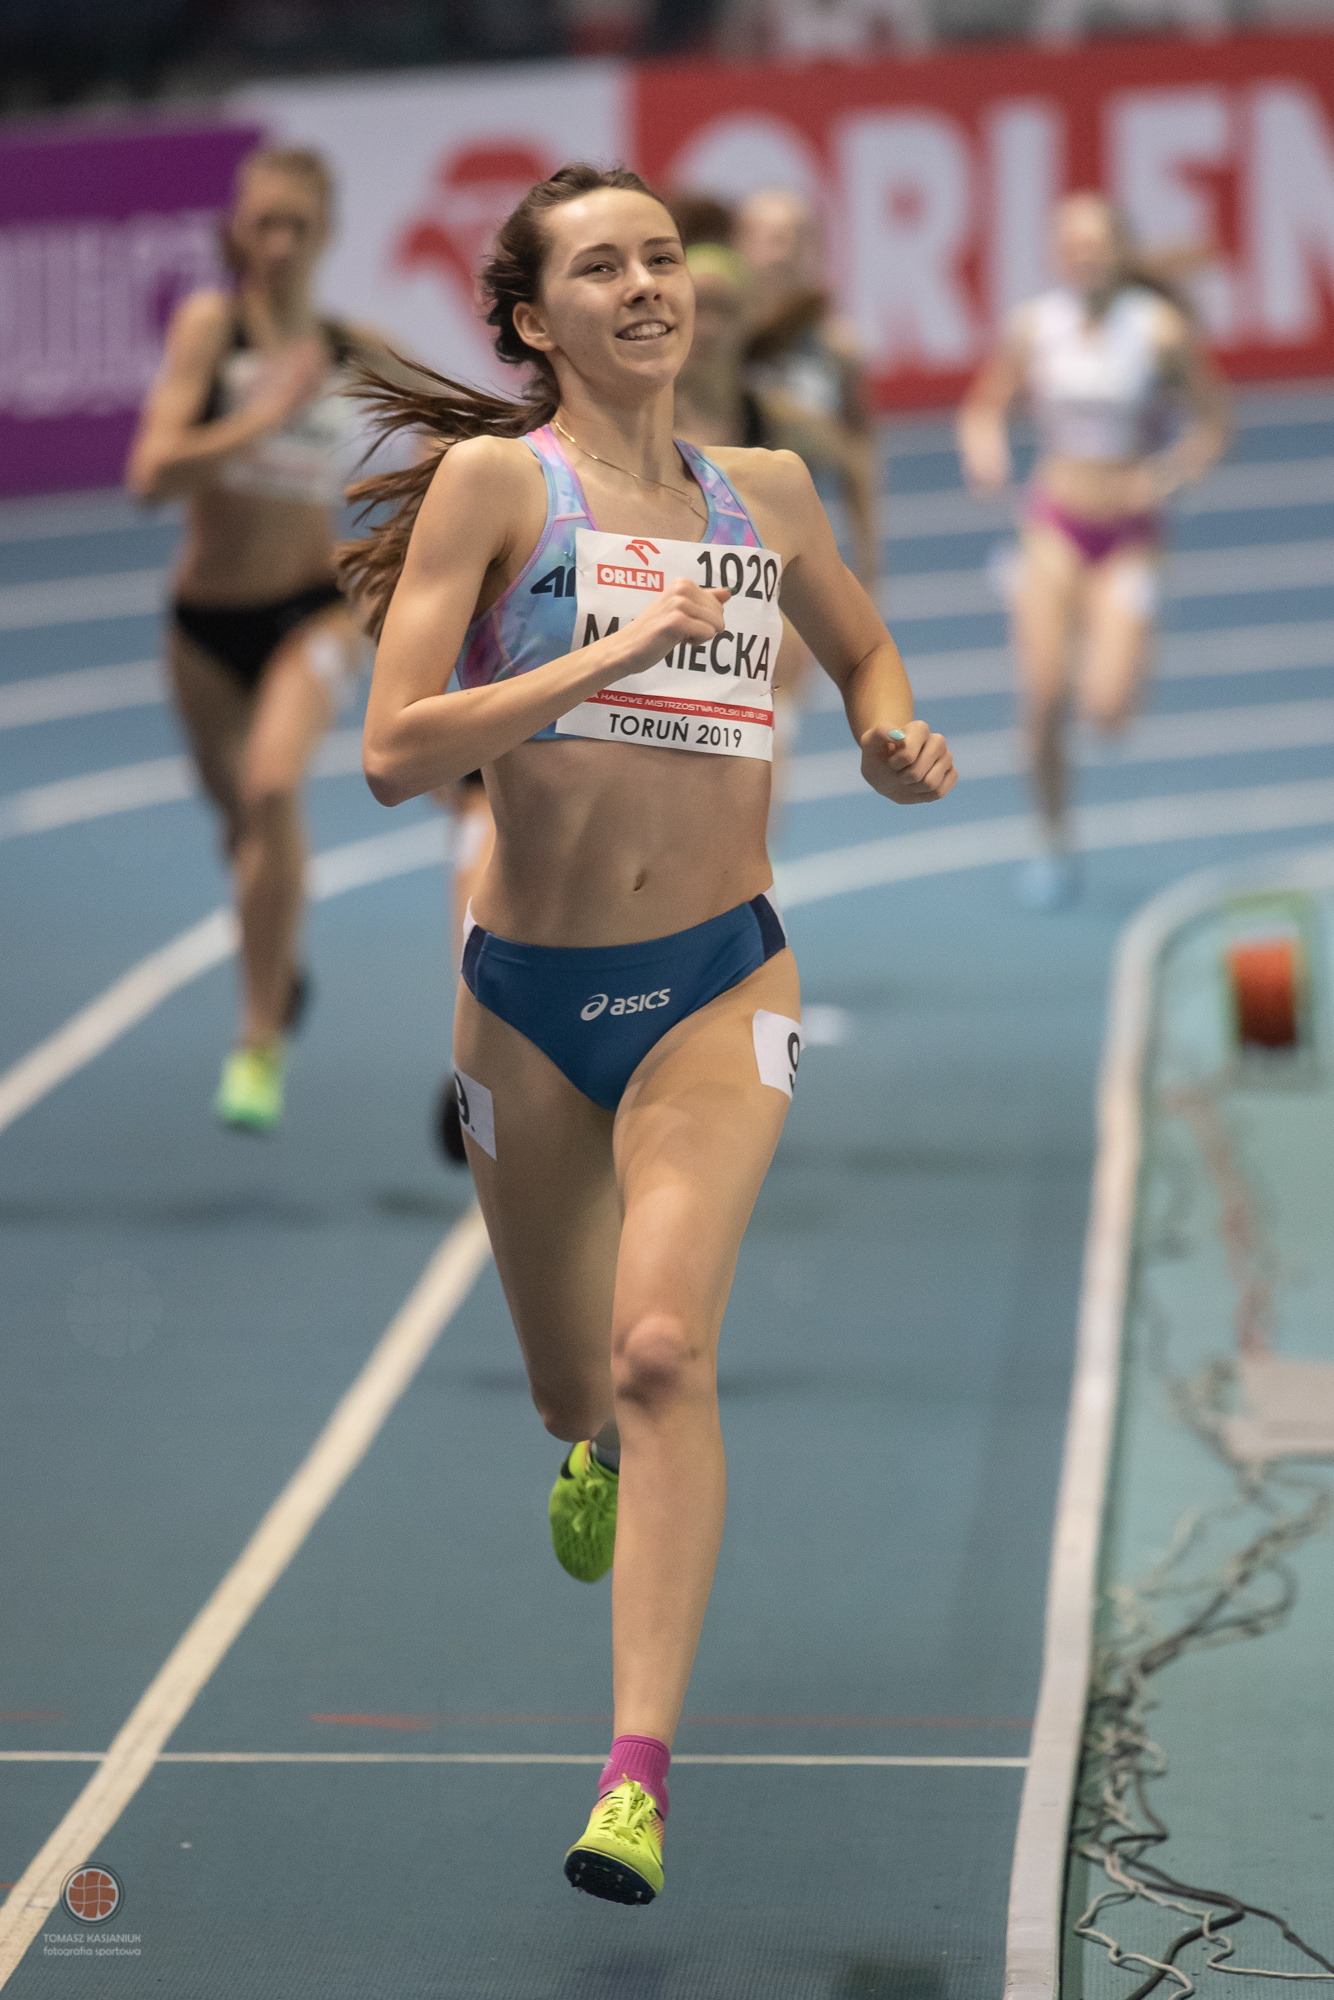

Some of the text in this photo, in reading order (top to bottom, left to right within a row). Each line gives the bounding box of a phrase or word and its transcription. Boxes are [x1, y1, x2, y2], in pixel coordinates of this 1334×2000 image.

[600, 567, 661, 589] ORLEN
[696, 551, 778, 603] 1020
[582, 613, 770, 681] MIECKA
[600, 694, 643, 705] HALOWE
[644, 699, 713, 713] MISTRZOSTWA
[714, 706, 740, 717] POLSKI
[609, 713, 742, 748] TORUŃ 2019
